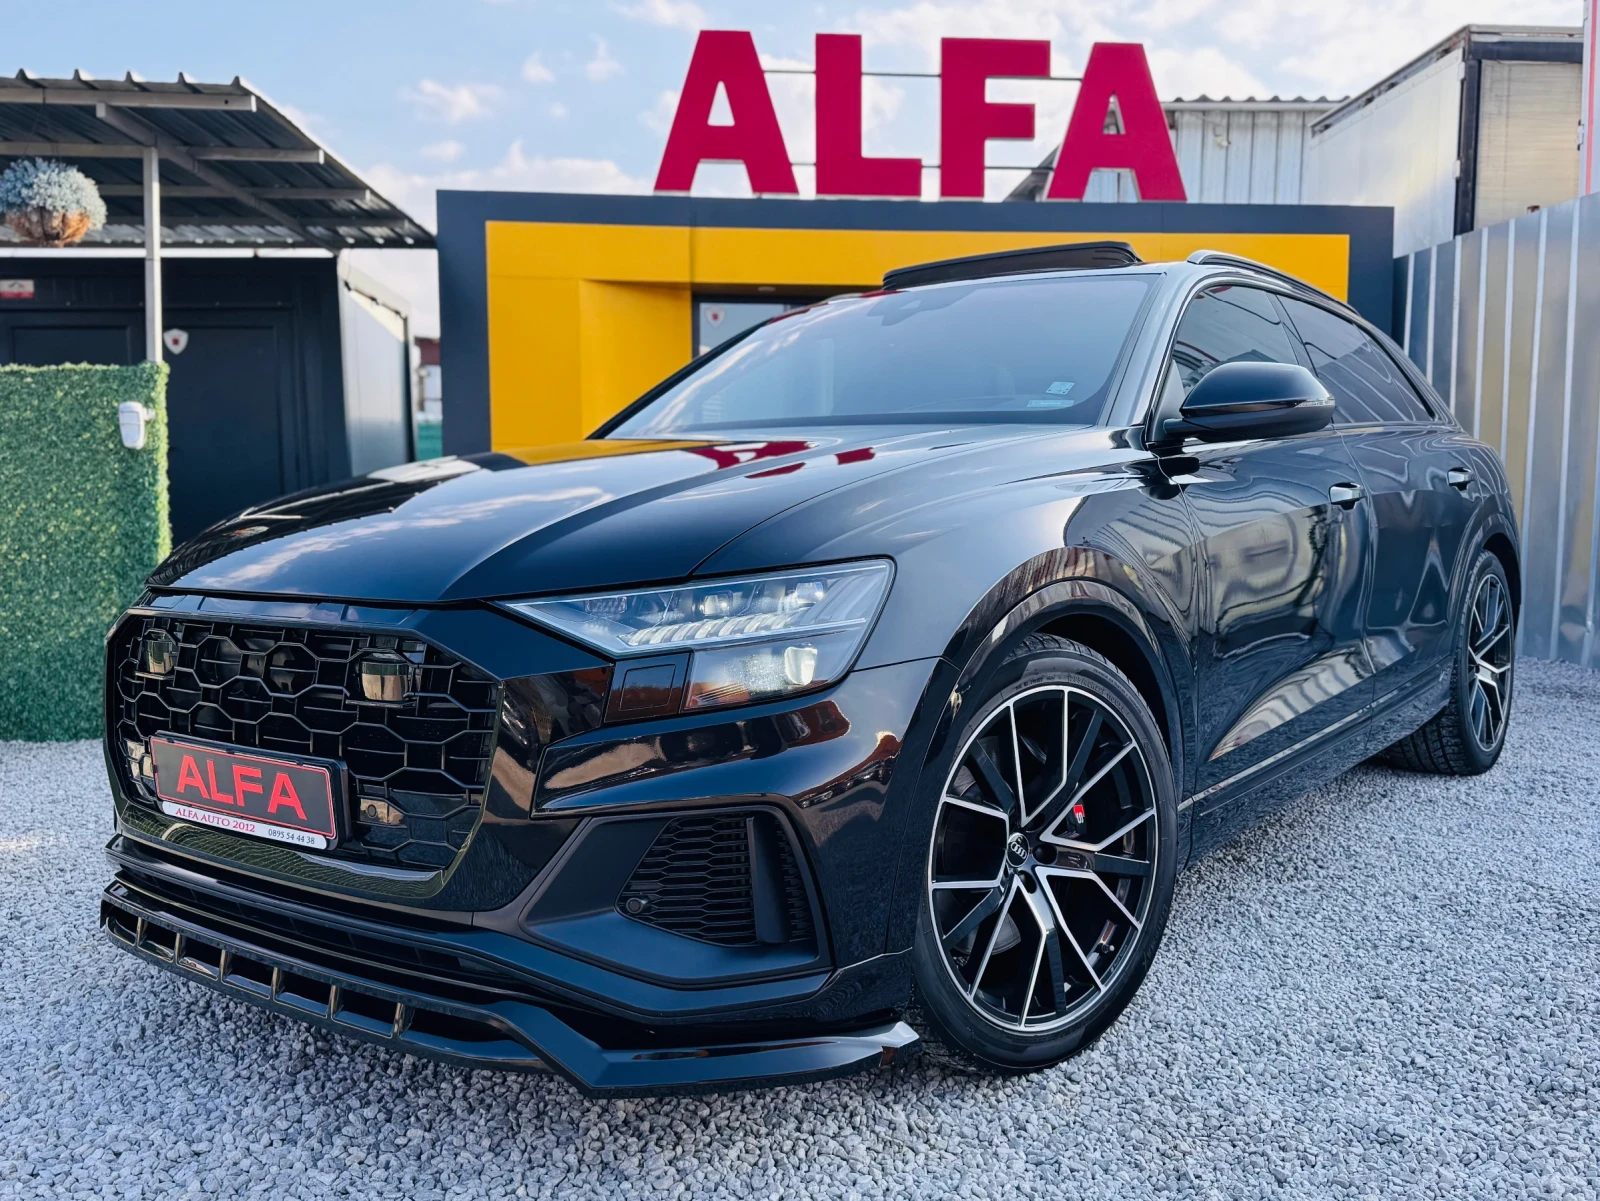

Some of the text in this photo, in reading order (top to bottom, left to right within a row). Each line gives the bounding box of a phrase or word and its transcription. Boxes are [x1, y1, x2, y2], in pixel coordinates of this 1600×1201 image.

[653, 30, 1188, 201] ALFA
[176, 754, 308, 821] ALFA
[175, 808, 256, 833] ALFA AUTO 2012
[268, 828, 315, 845] 0895 54 44 38
